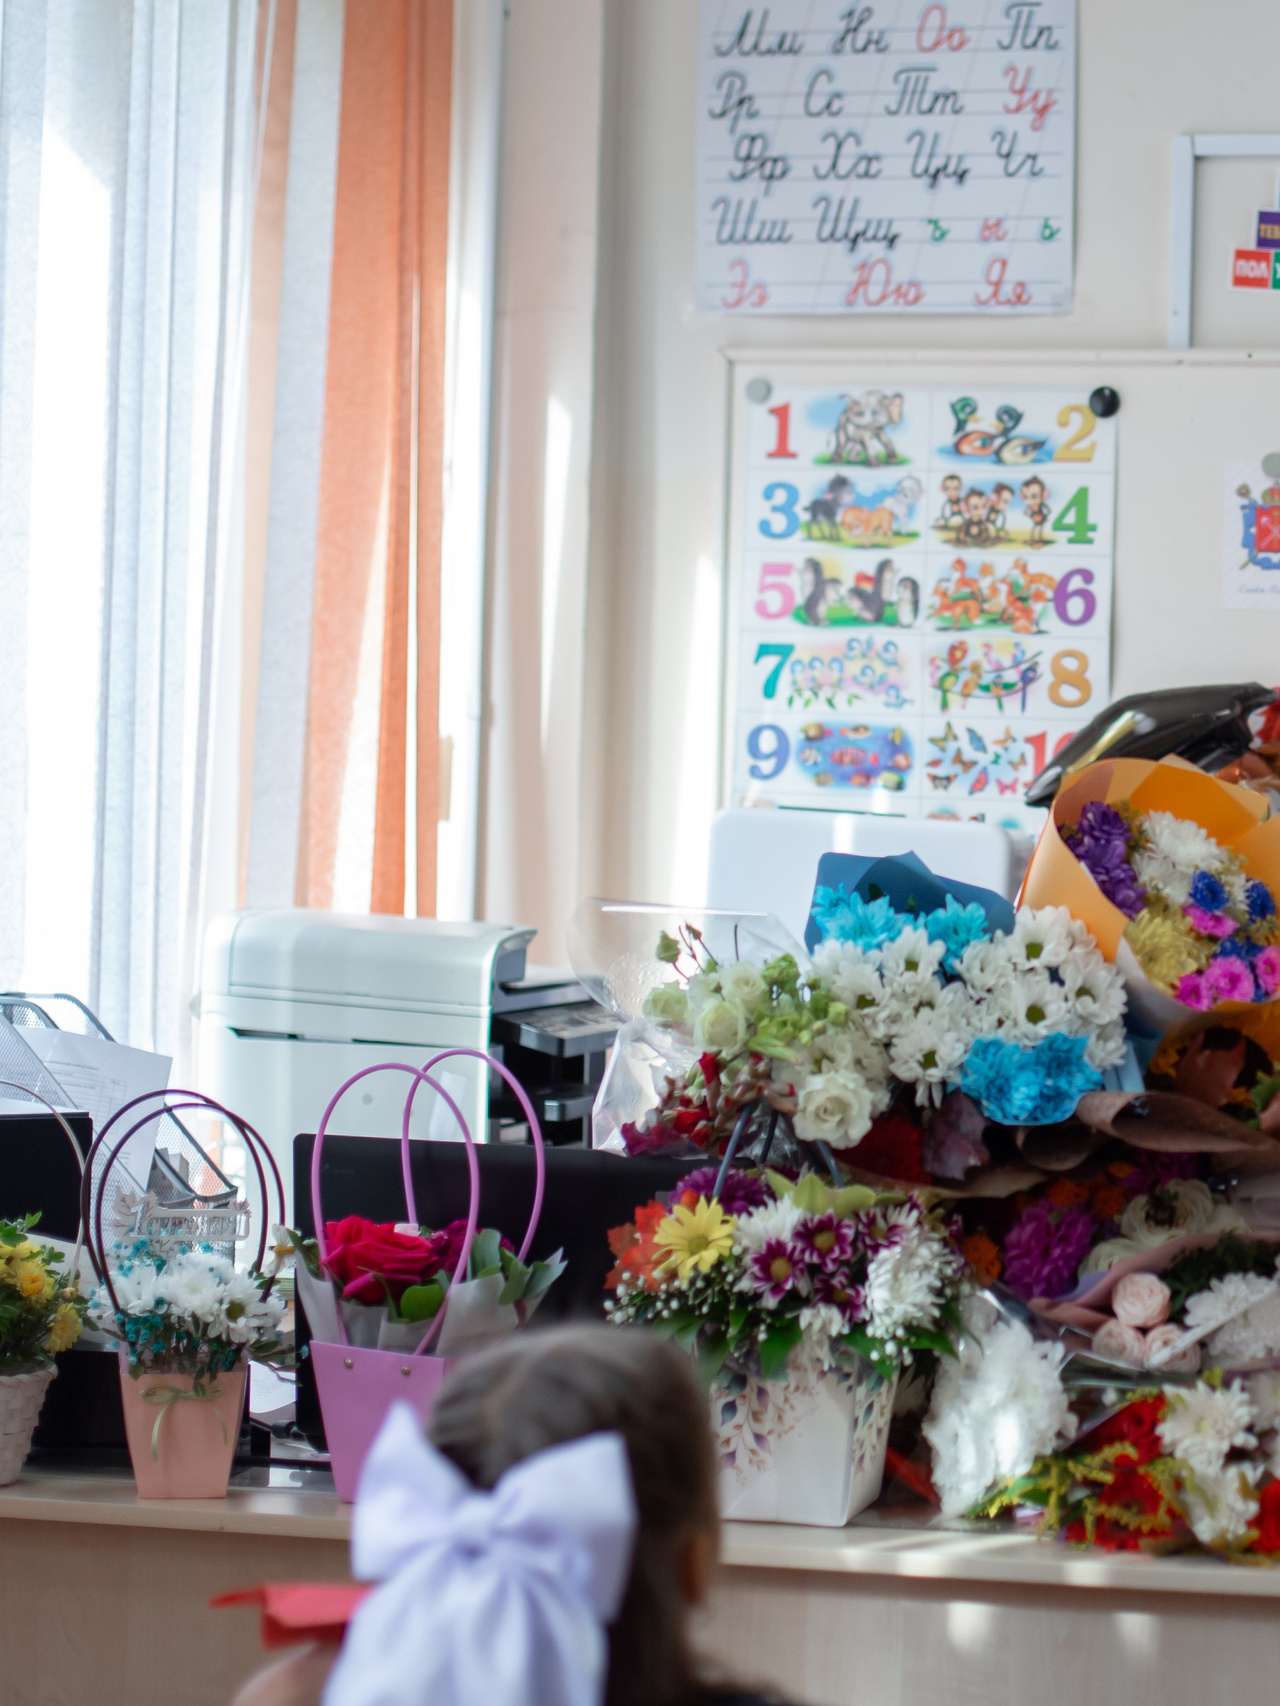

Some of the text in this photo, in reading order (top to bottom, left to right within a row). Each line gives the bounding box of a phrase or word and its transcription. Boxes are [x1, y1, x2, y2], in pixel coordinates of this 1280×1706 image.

[767, 402, 1099, 463] 1 2
[759, 482, 1098, 545] 3 4
[755, 562, 1097, 626] 5 6
[753, 643, 1092, 707] 7 8
[747, 724, 790, 780] 9
